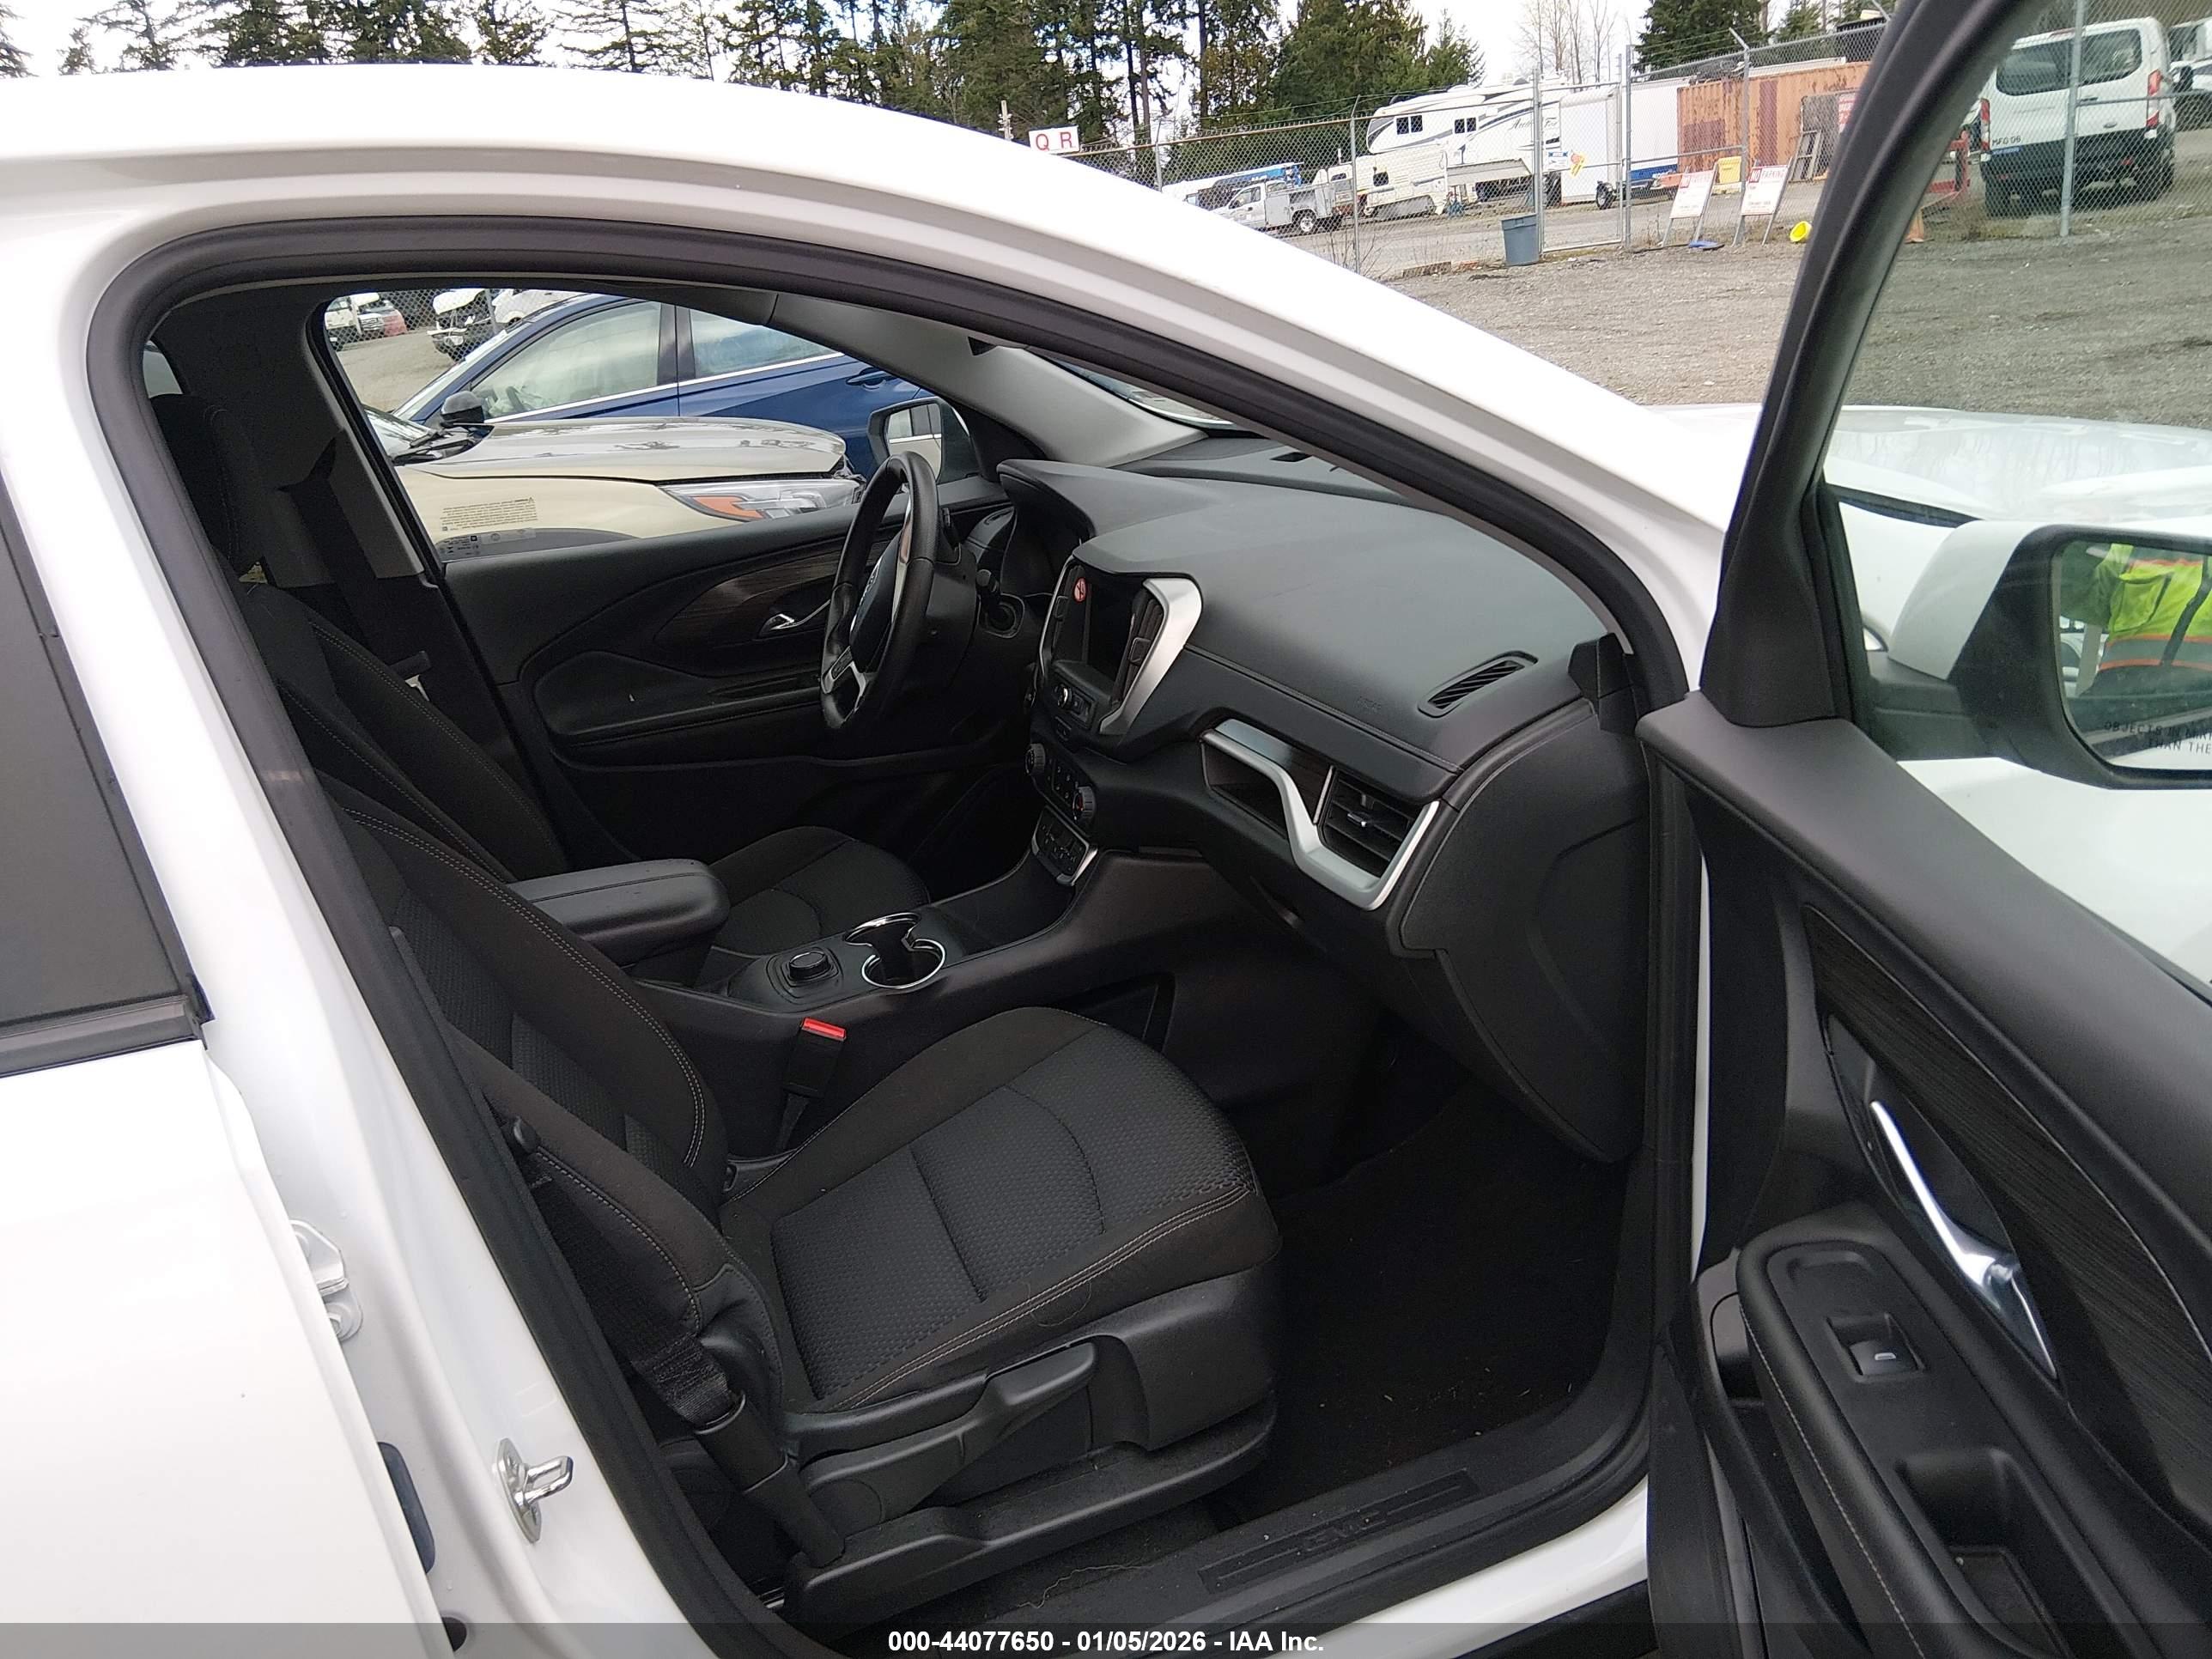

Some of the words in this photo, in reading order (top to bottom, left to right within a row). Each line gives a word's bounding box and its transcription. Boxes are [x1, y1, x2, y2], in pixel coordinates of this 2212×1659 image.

[1036, 133, 1050, 151] Q
[1060, 131, 1073, 149] R
[2103, 720, 2163, 736] OBJECTS
